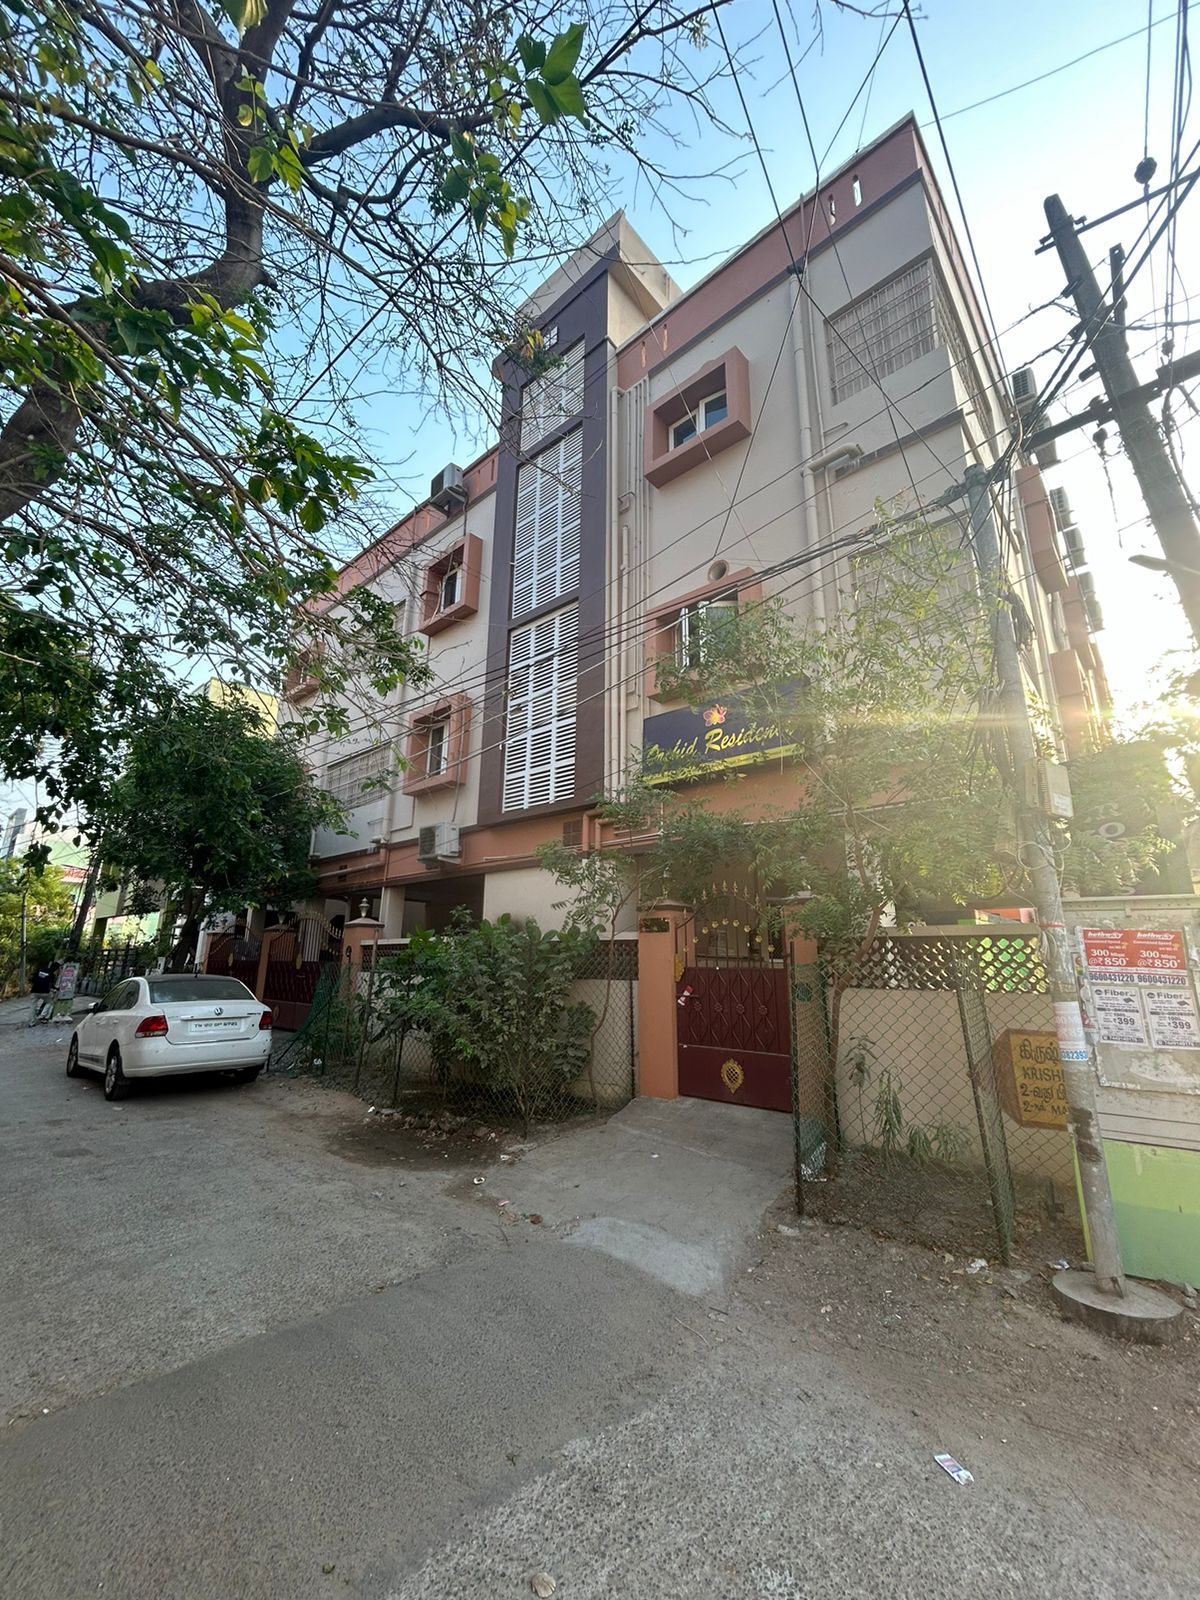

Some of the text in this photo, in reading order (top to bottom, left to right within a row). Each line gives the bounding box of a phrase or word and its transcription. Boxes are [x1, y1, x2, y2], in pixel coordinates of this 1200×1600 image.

[1090, 948, 1110, 957] 300
[1139, 950, 1160, 959] 300
[1104, 989, 1130, 997] Fiber
[1157, 992, 1184, 1000] Fiber
